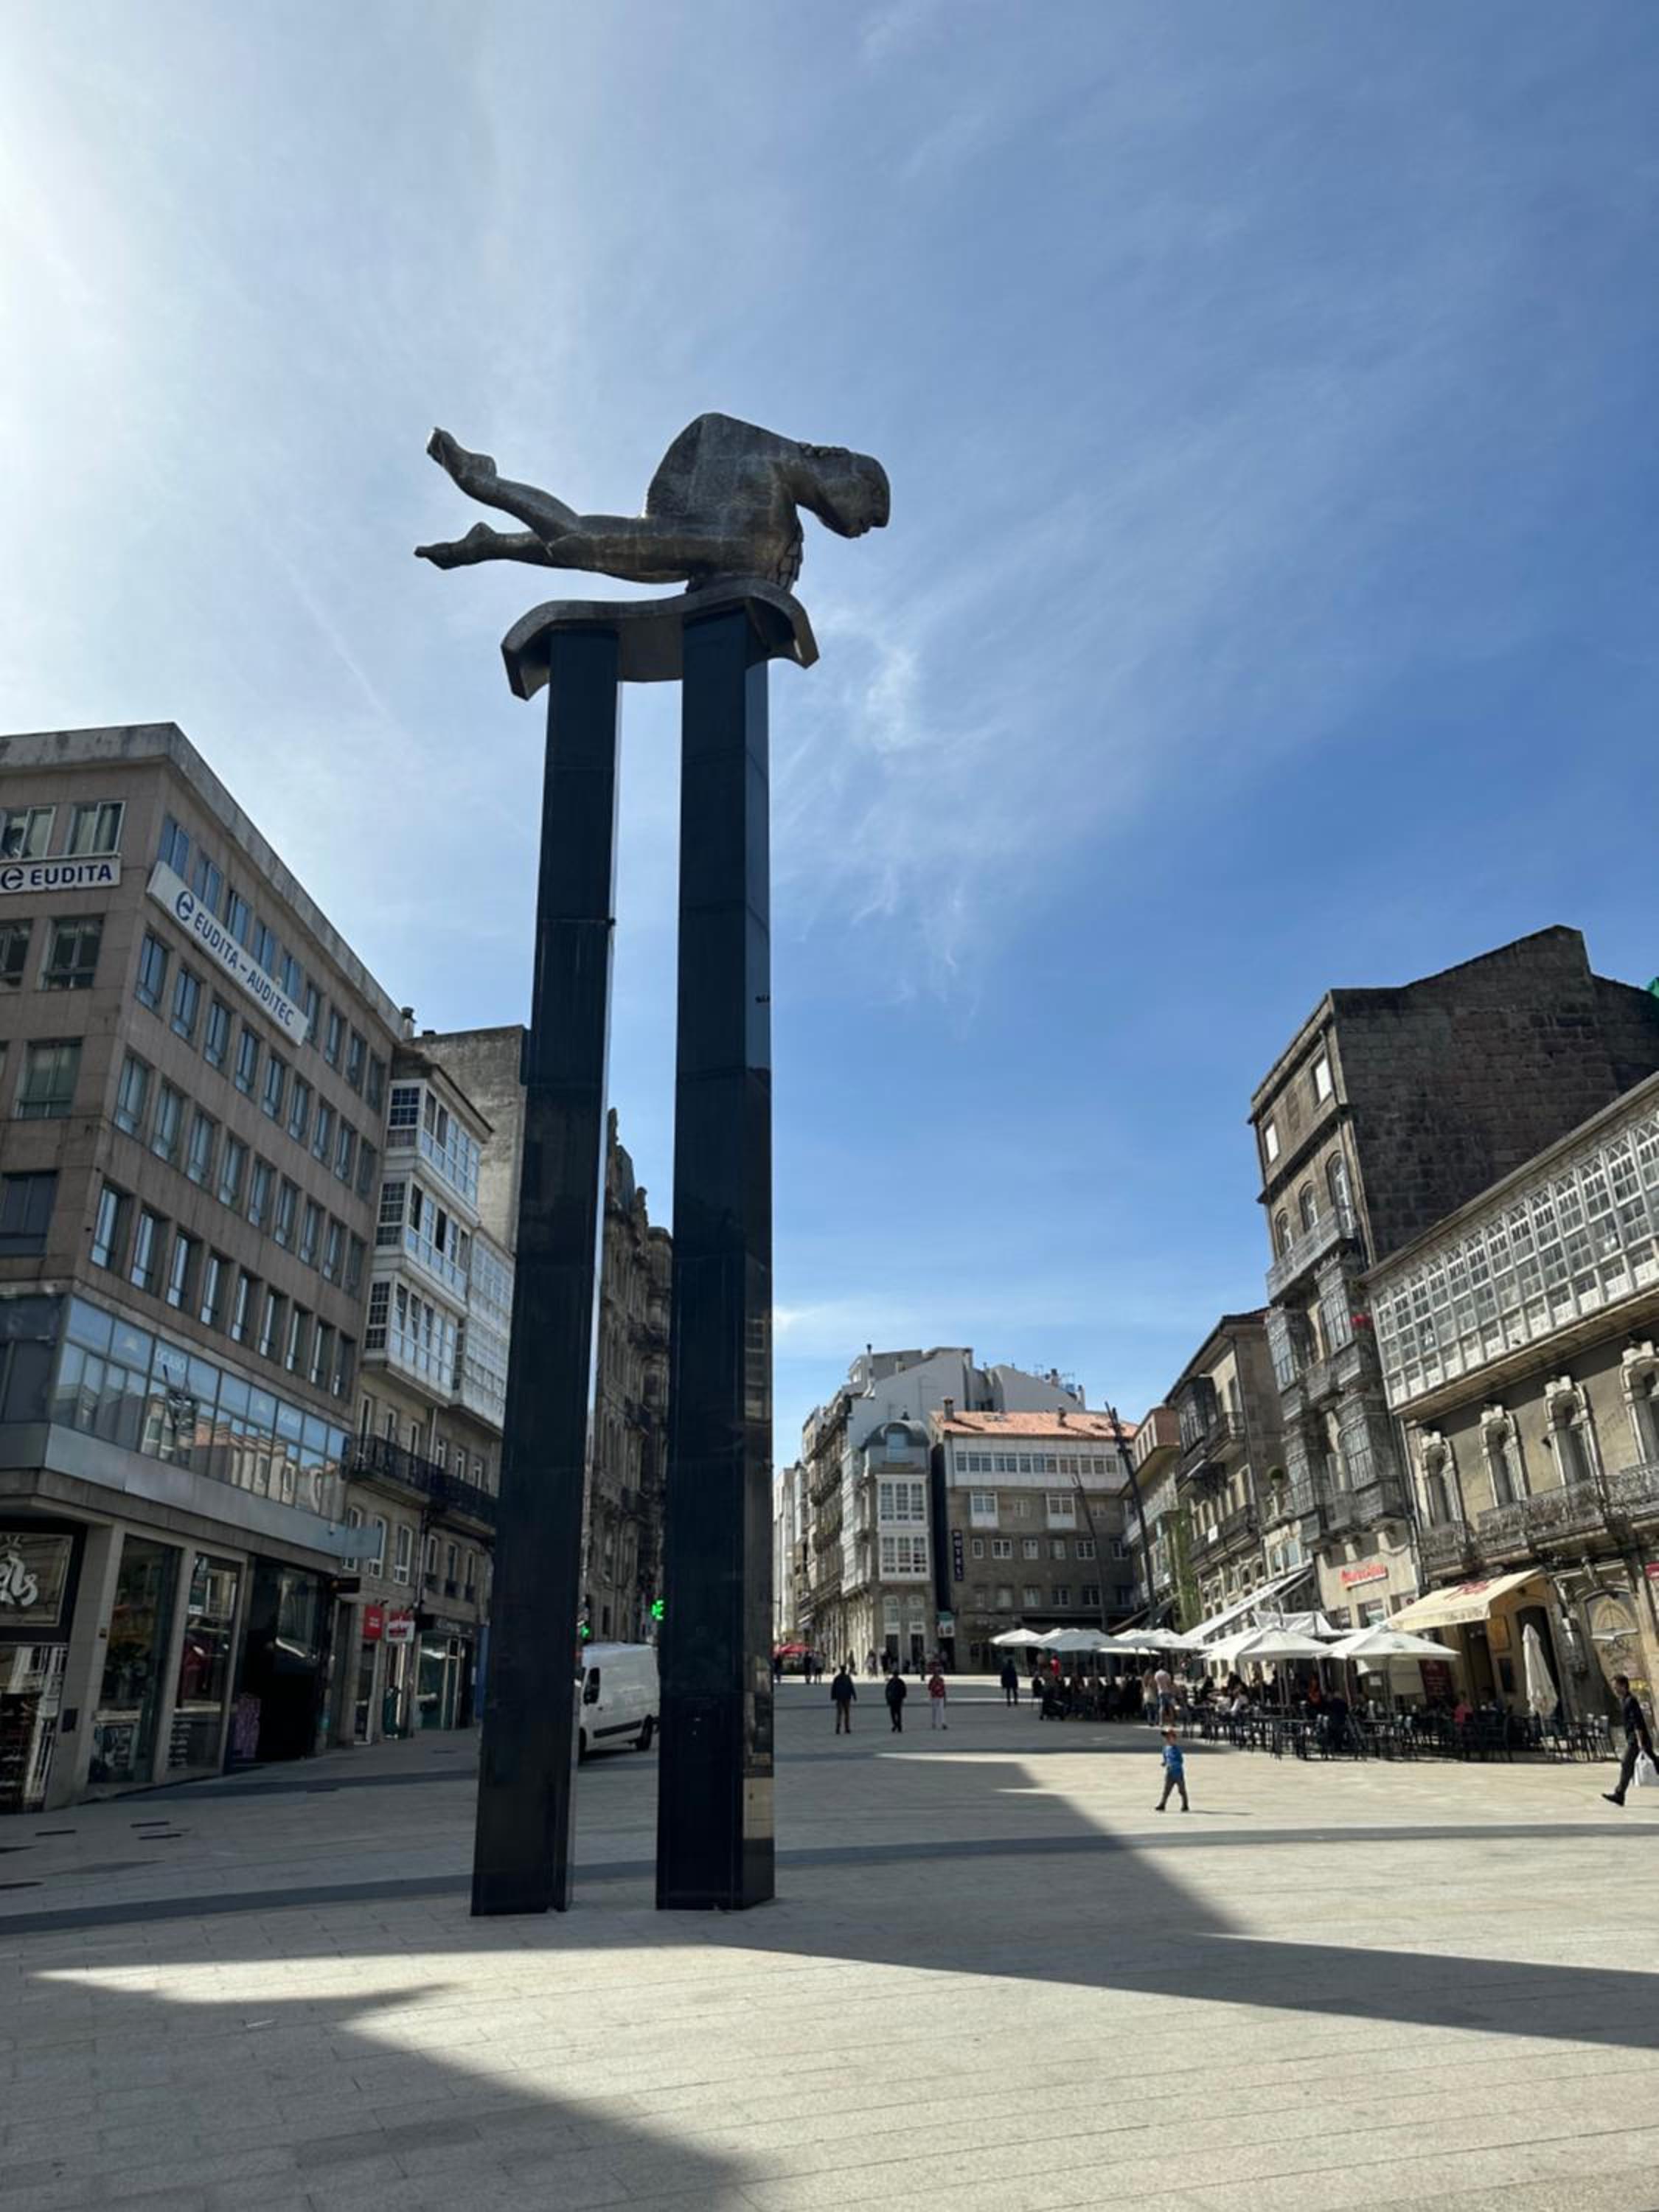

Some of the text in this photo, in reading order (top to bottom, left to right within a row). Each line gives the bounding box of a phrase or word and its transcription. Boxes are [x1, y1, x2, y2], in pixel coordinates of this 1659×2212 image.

[30, 863, 113, 886] EUDITA
[194, 911, 239, 969] EUDITA
[246, 970, 296, 1027] AUDITEC
